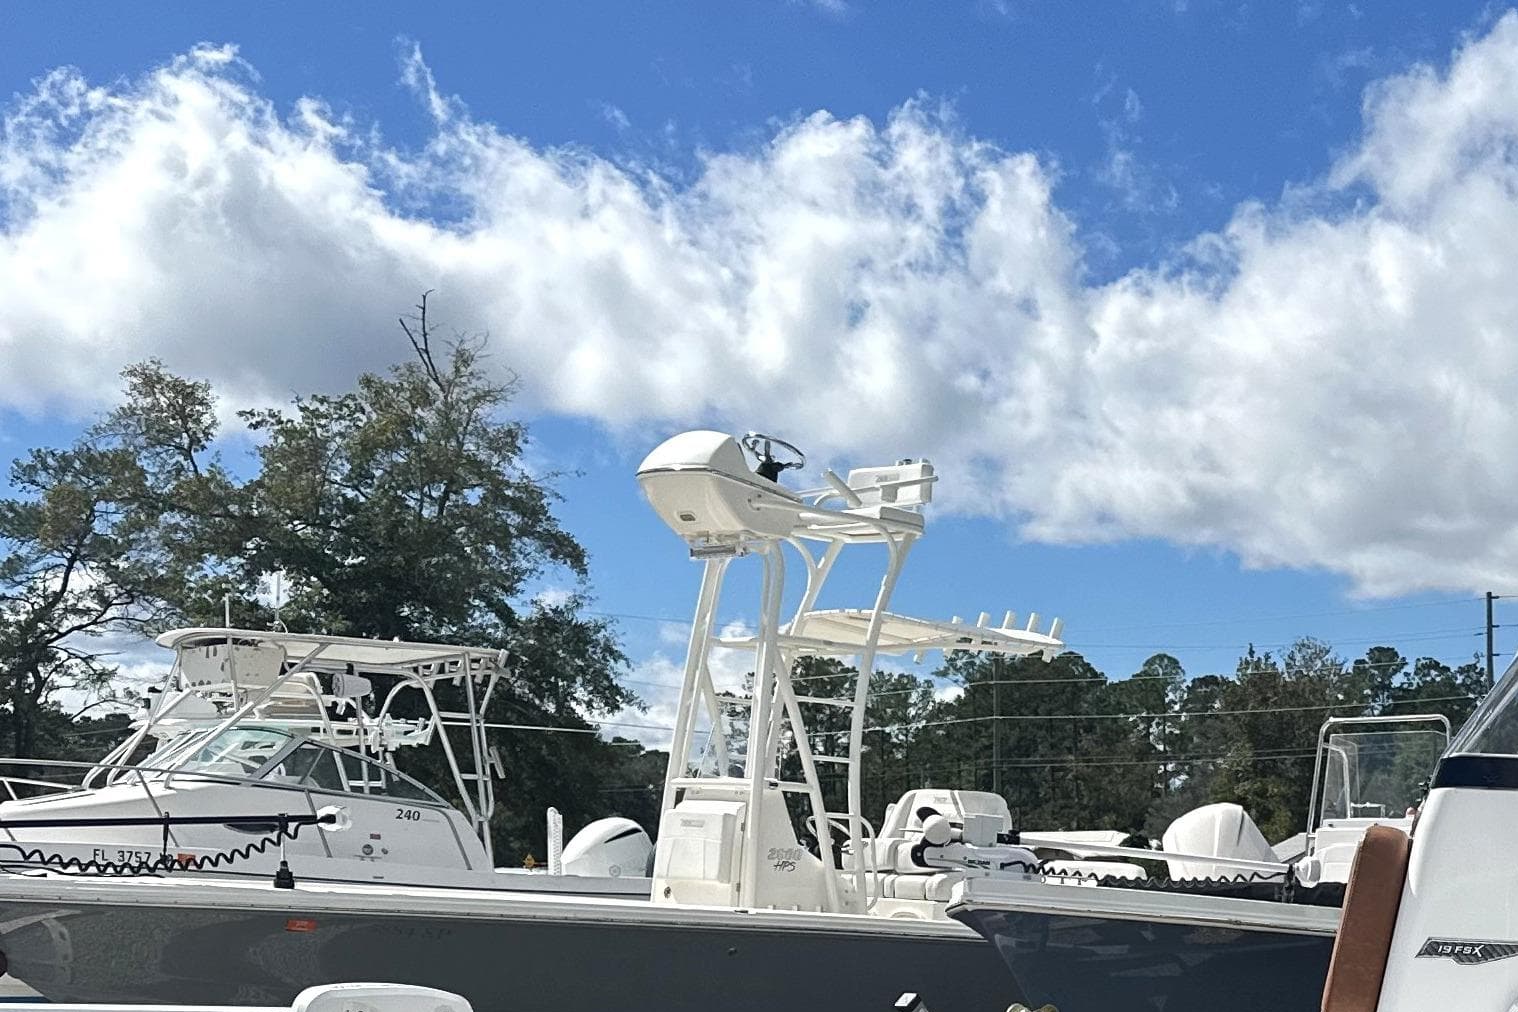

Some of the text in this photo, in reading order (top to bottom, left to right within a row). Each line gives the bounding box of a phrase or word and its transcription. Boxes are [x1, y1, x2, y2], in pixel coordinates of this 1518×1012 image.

[395, 808, 421, 822] 240
[93, 848, 108, 863] FL
[1437, 944, 1484, 957] 19 FSX
